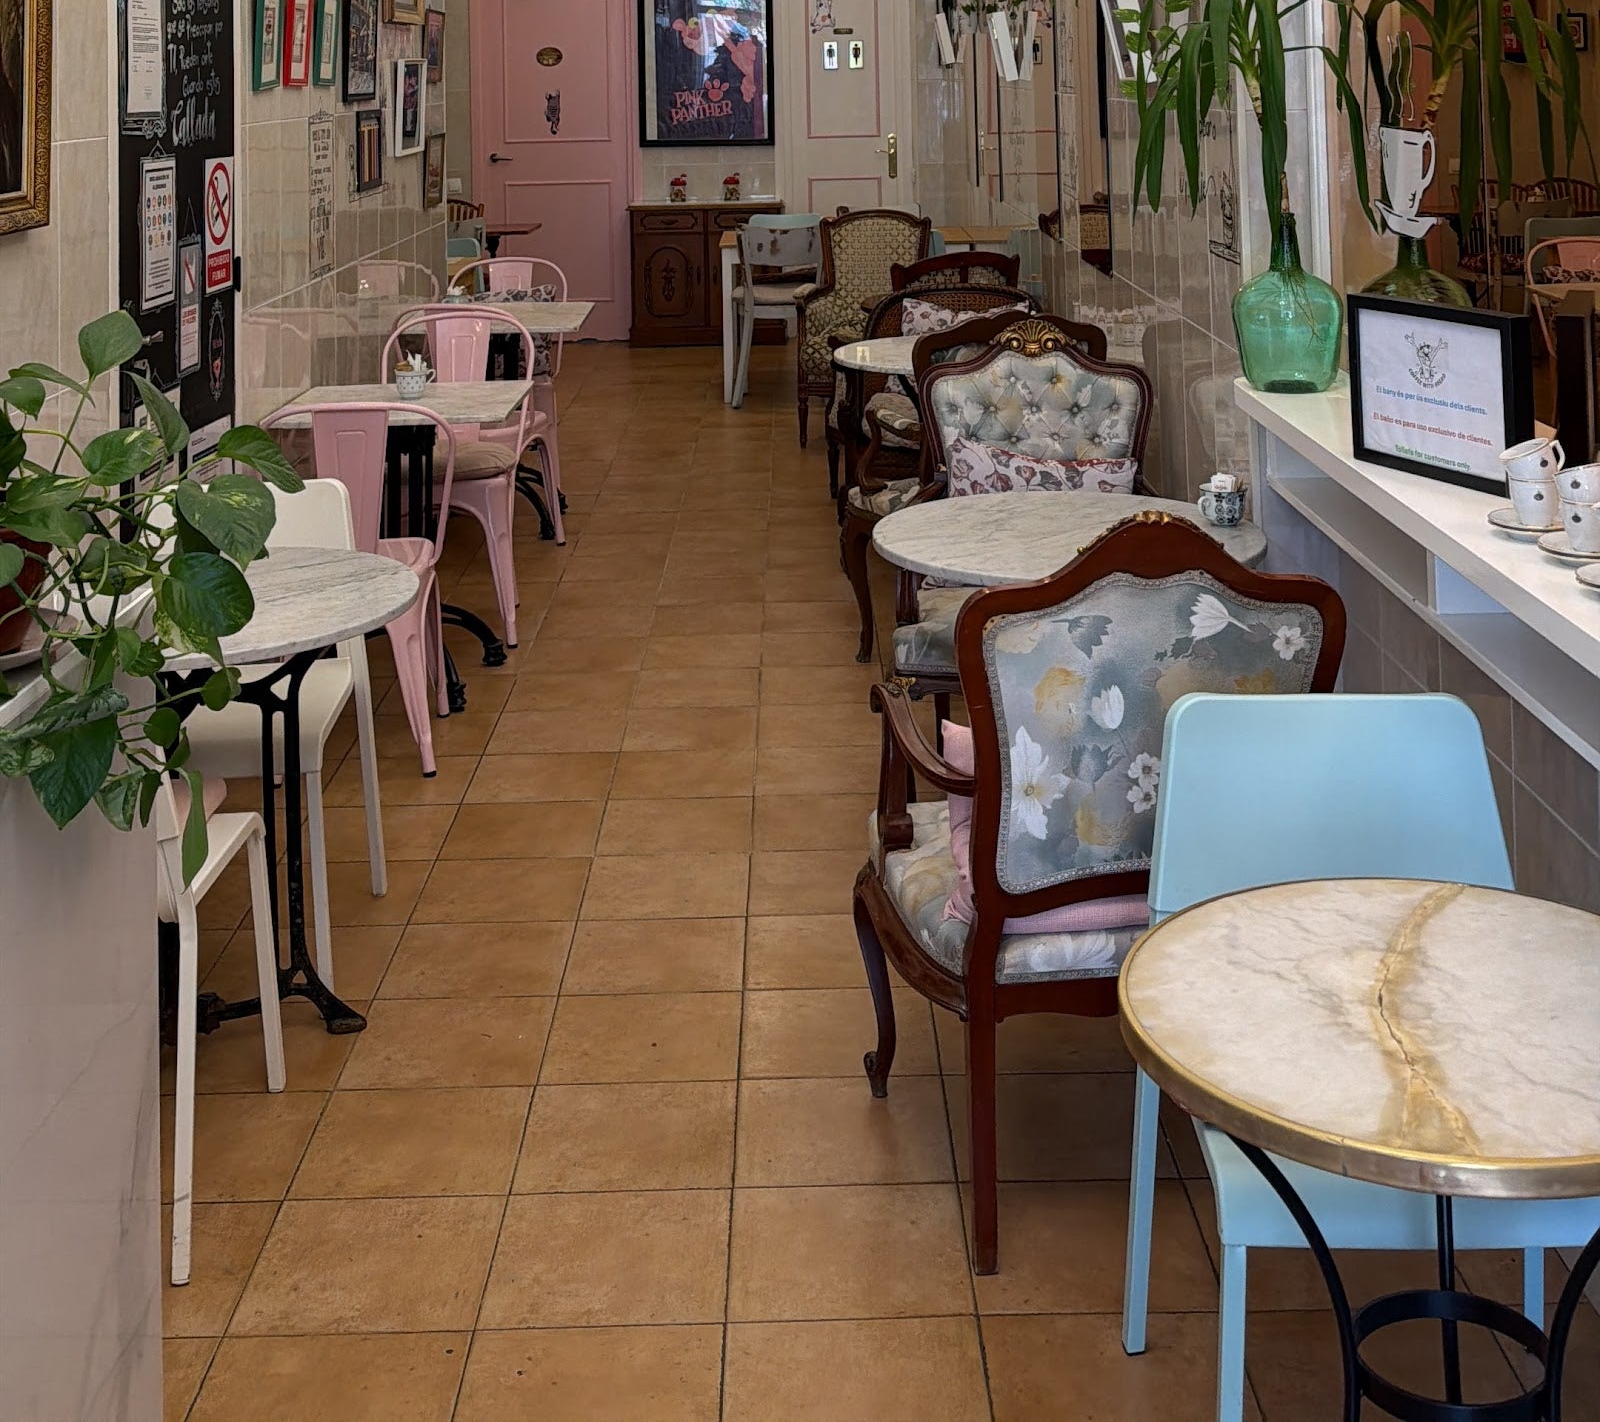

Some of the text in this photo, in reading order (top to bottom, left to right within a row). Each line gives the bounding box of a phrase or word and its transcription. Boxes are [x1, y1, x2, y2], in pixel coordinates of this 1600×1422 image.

[674, 90, 707, 108] PINK
[671, 100, 733, 126] PANTHER
[1383, 387, 1396, 397] bany
[1424, 396, 1448, 407] exclusiu
[1449, 401, 1464, 410] dels
[1464, 404, 1488, 415] clients.
[1380, 413, 1394, 423] baño
[1402, 419, 1416, 429] para
[1416, 423, 1427, 432] uso
[1428, 426, 1457, 438] exclusivo
[1457, 431, 1466, 440] de
[1466, 434, 1493, 446] clientes.
[1414, 449, 1423, 458] for
[1424, 453, 1456, 467] customers
[1457, 459, 1472, 472] only.
